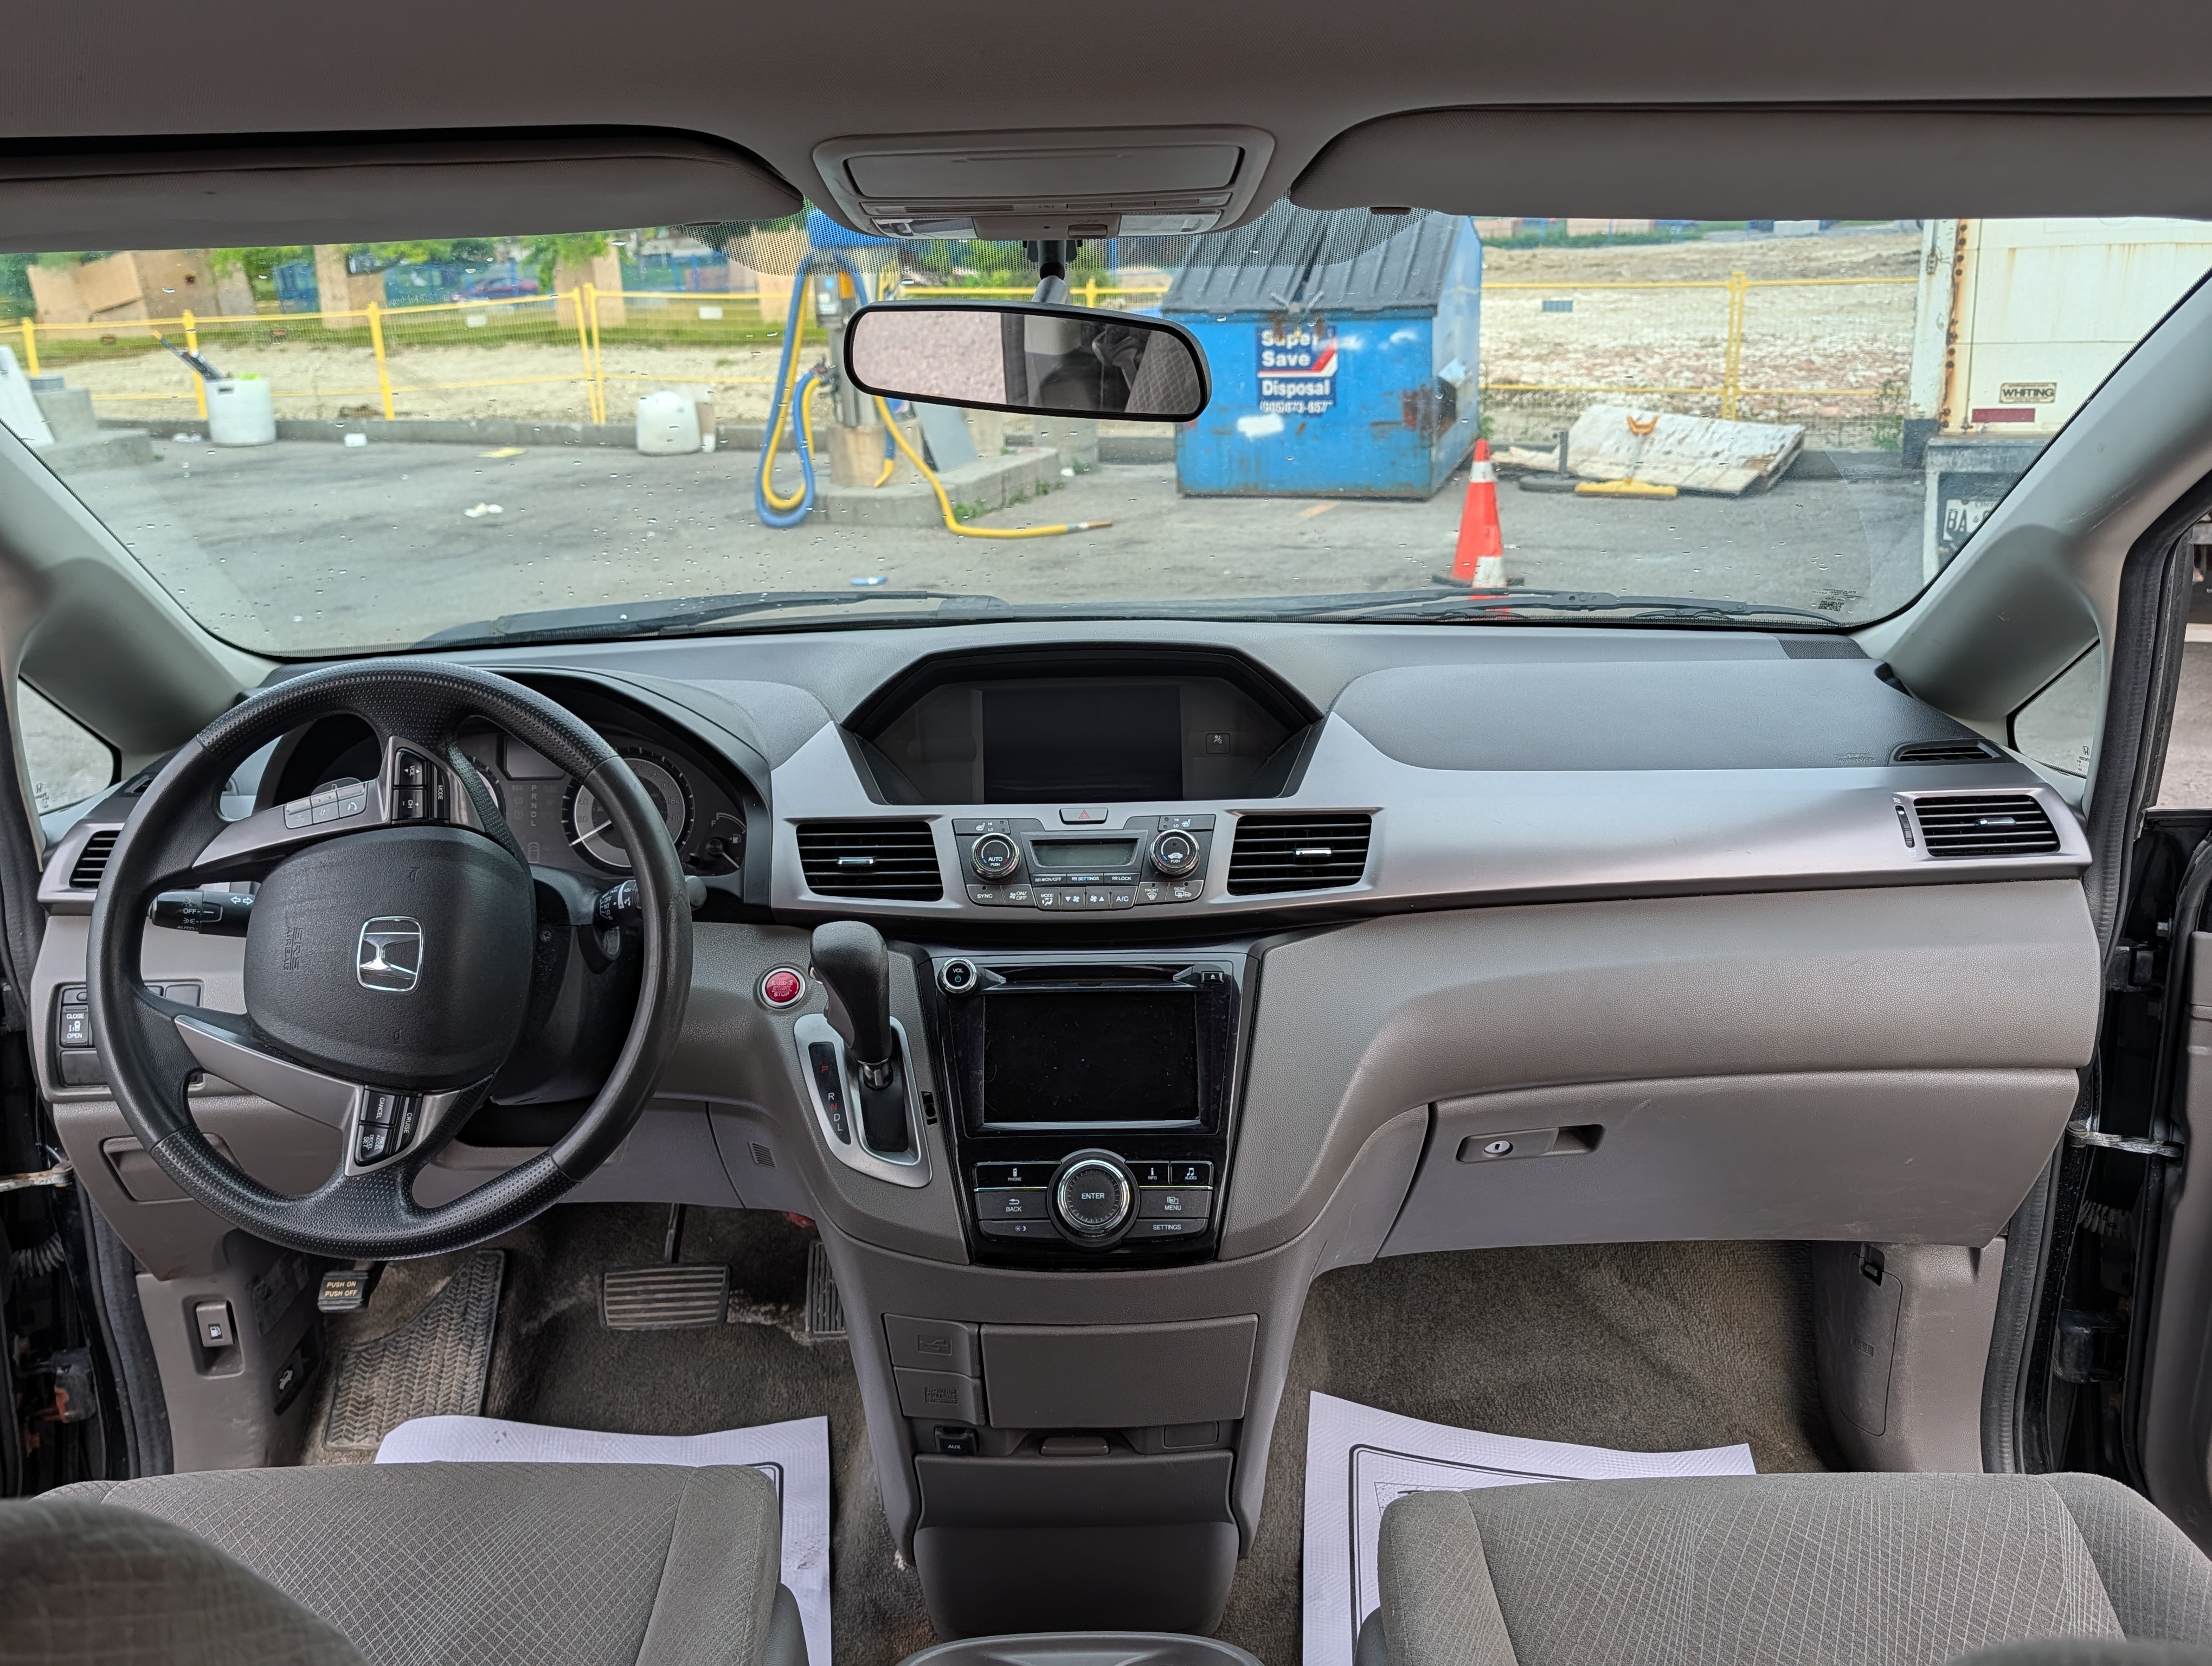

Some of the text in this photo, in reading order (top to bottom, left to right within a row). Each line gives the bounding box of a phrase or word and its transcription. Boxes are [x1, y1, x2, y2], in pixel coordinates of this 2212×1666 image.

[1262, 350, 1311, 367] Save
[1262, 379, 1330, 399] Disposal
[2002, 388, 2055, 397] WHITING
[821, 1065, 828, 1073] P
[828, 1092, 835, 1100] R
[376, 1097, 385, 1119] CANCEL
[830, 1103, 838, 1111] N
[833, 1113, 841, 1122] D
[403, 1112, 413, 1134] CRUISE
[837, 1123, 843, 1131] L
